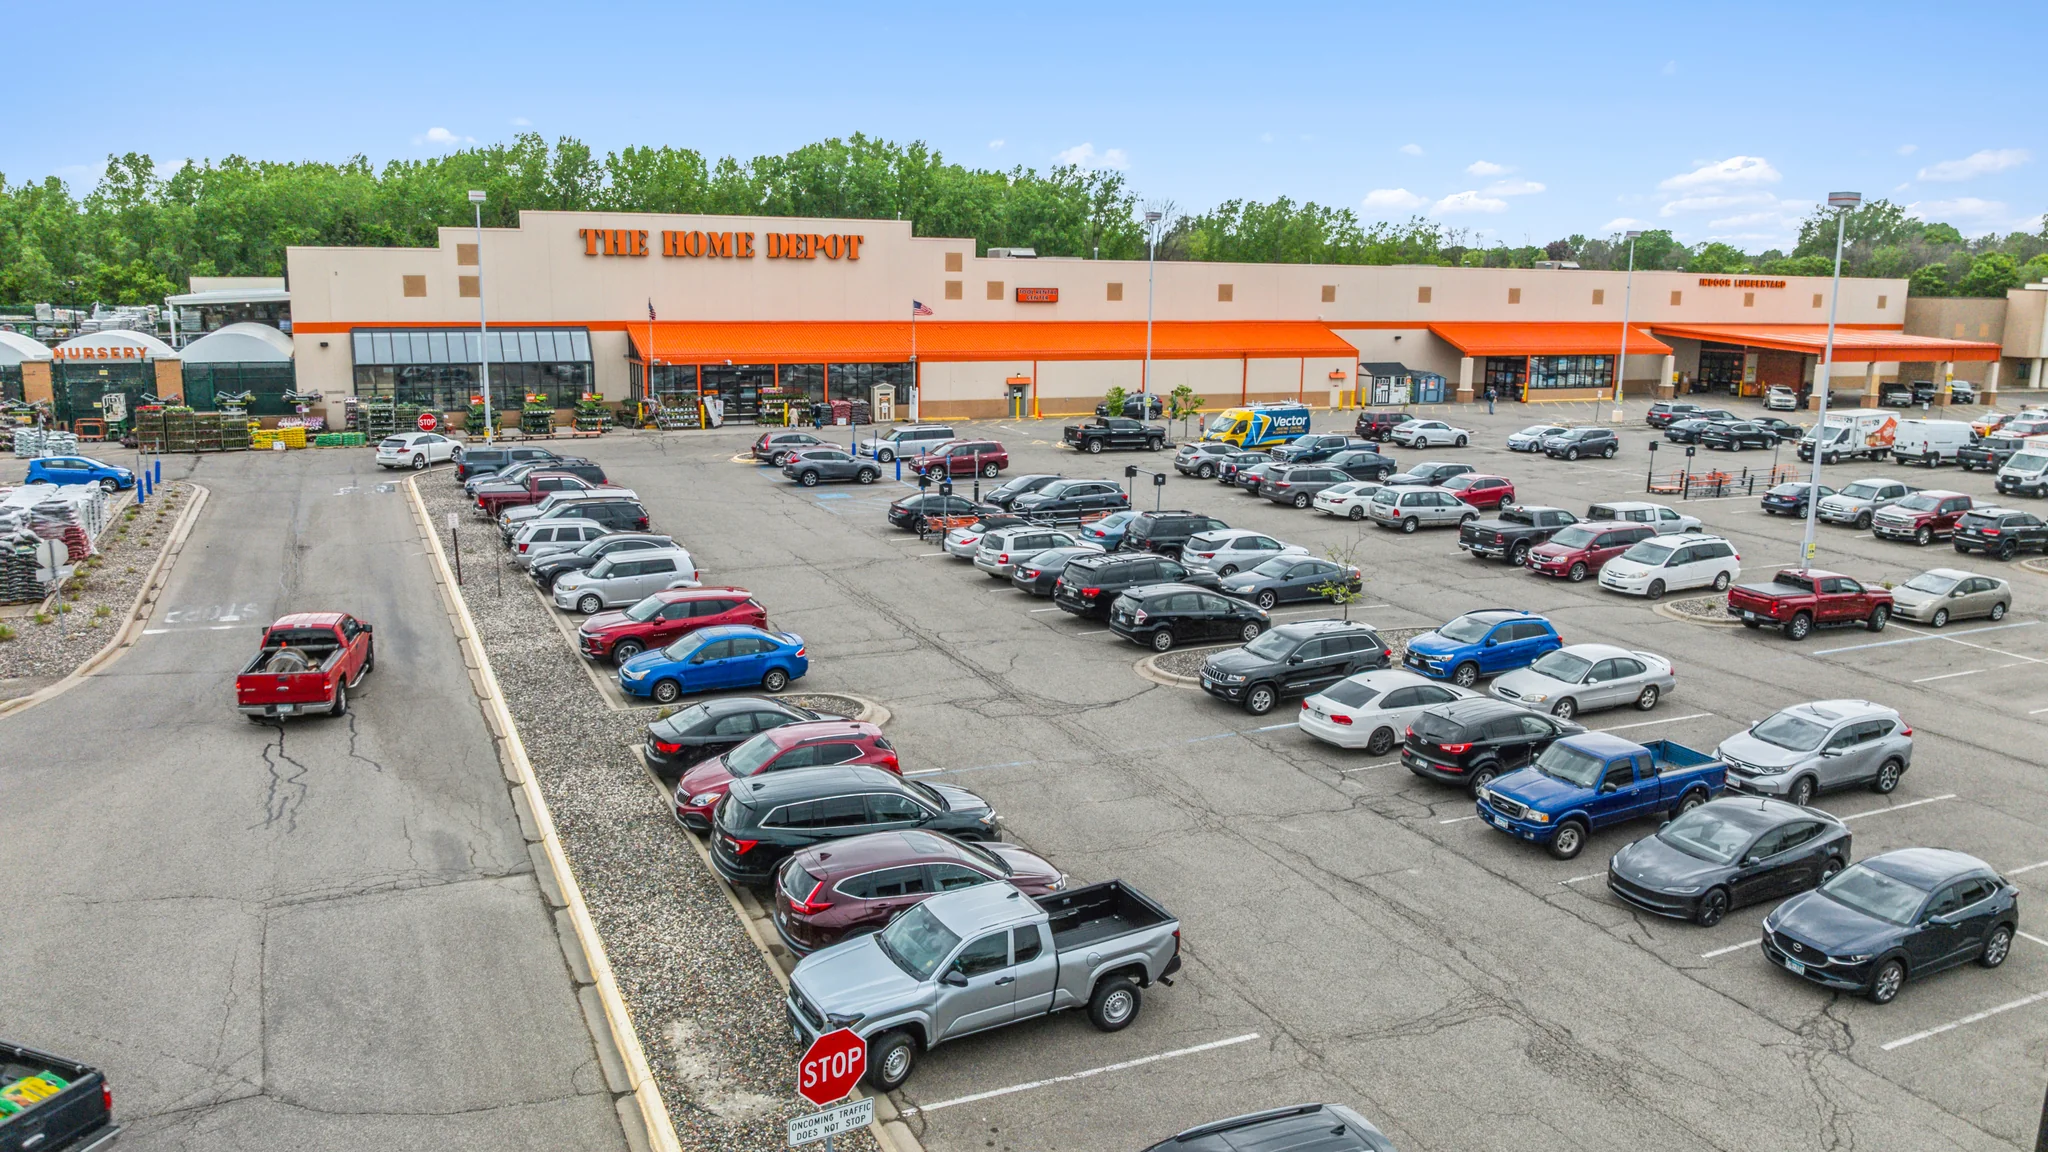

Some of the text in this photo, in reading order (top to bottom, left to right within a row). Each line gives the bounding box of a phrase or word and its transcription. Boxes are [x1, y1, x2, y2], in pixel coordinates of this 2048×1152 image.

[579, 228, 864, 260] THE HOME DEPOT
[1699, 278, 1786, 288] INDOOR LUMBERYARD
[52, 346, 148, 360] NURSERY
[420, 418, 436, 427] STOP
[1273, 415, 1307, 427] Vector
[803, 1046, 862, 1088] STOP
[791, 1102, 872, 1131] ONCOMING TRAFFIC
[796, 1114, 866, 1141] DOES NOT STOP
